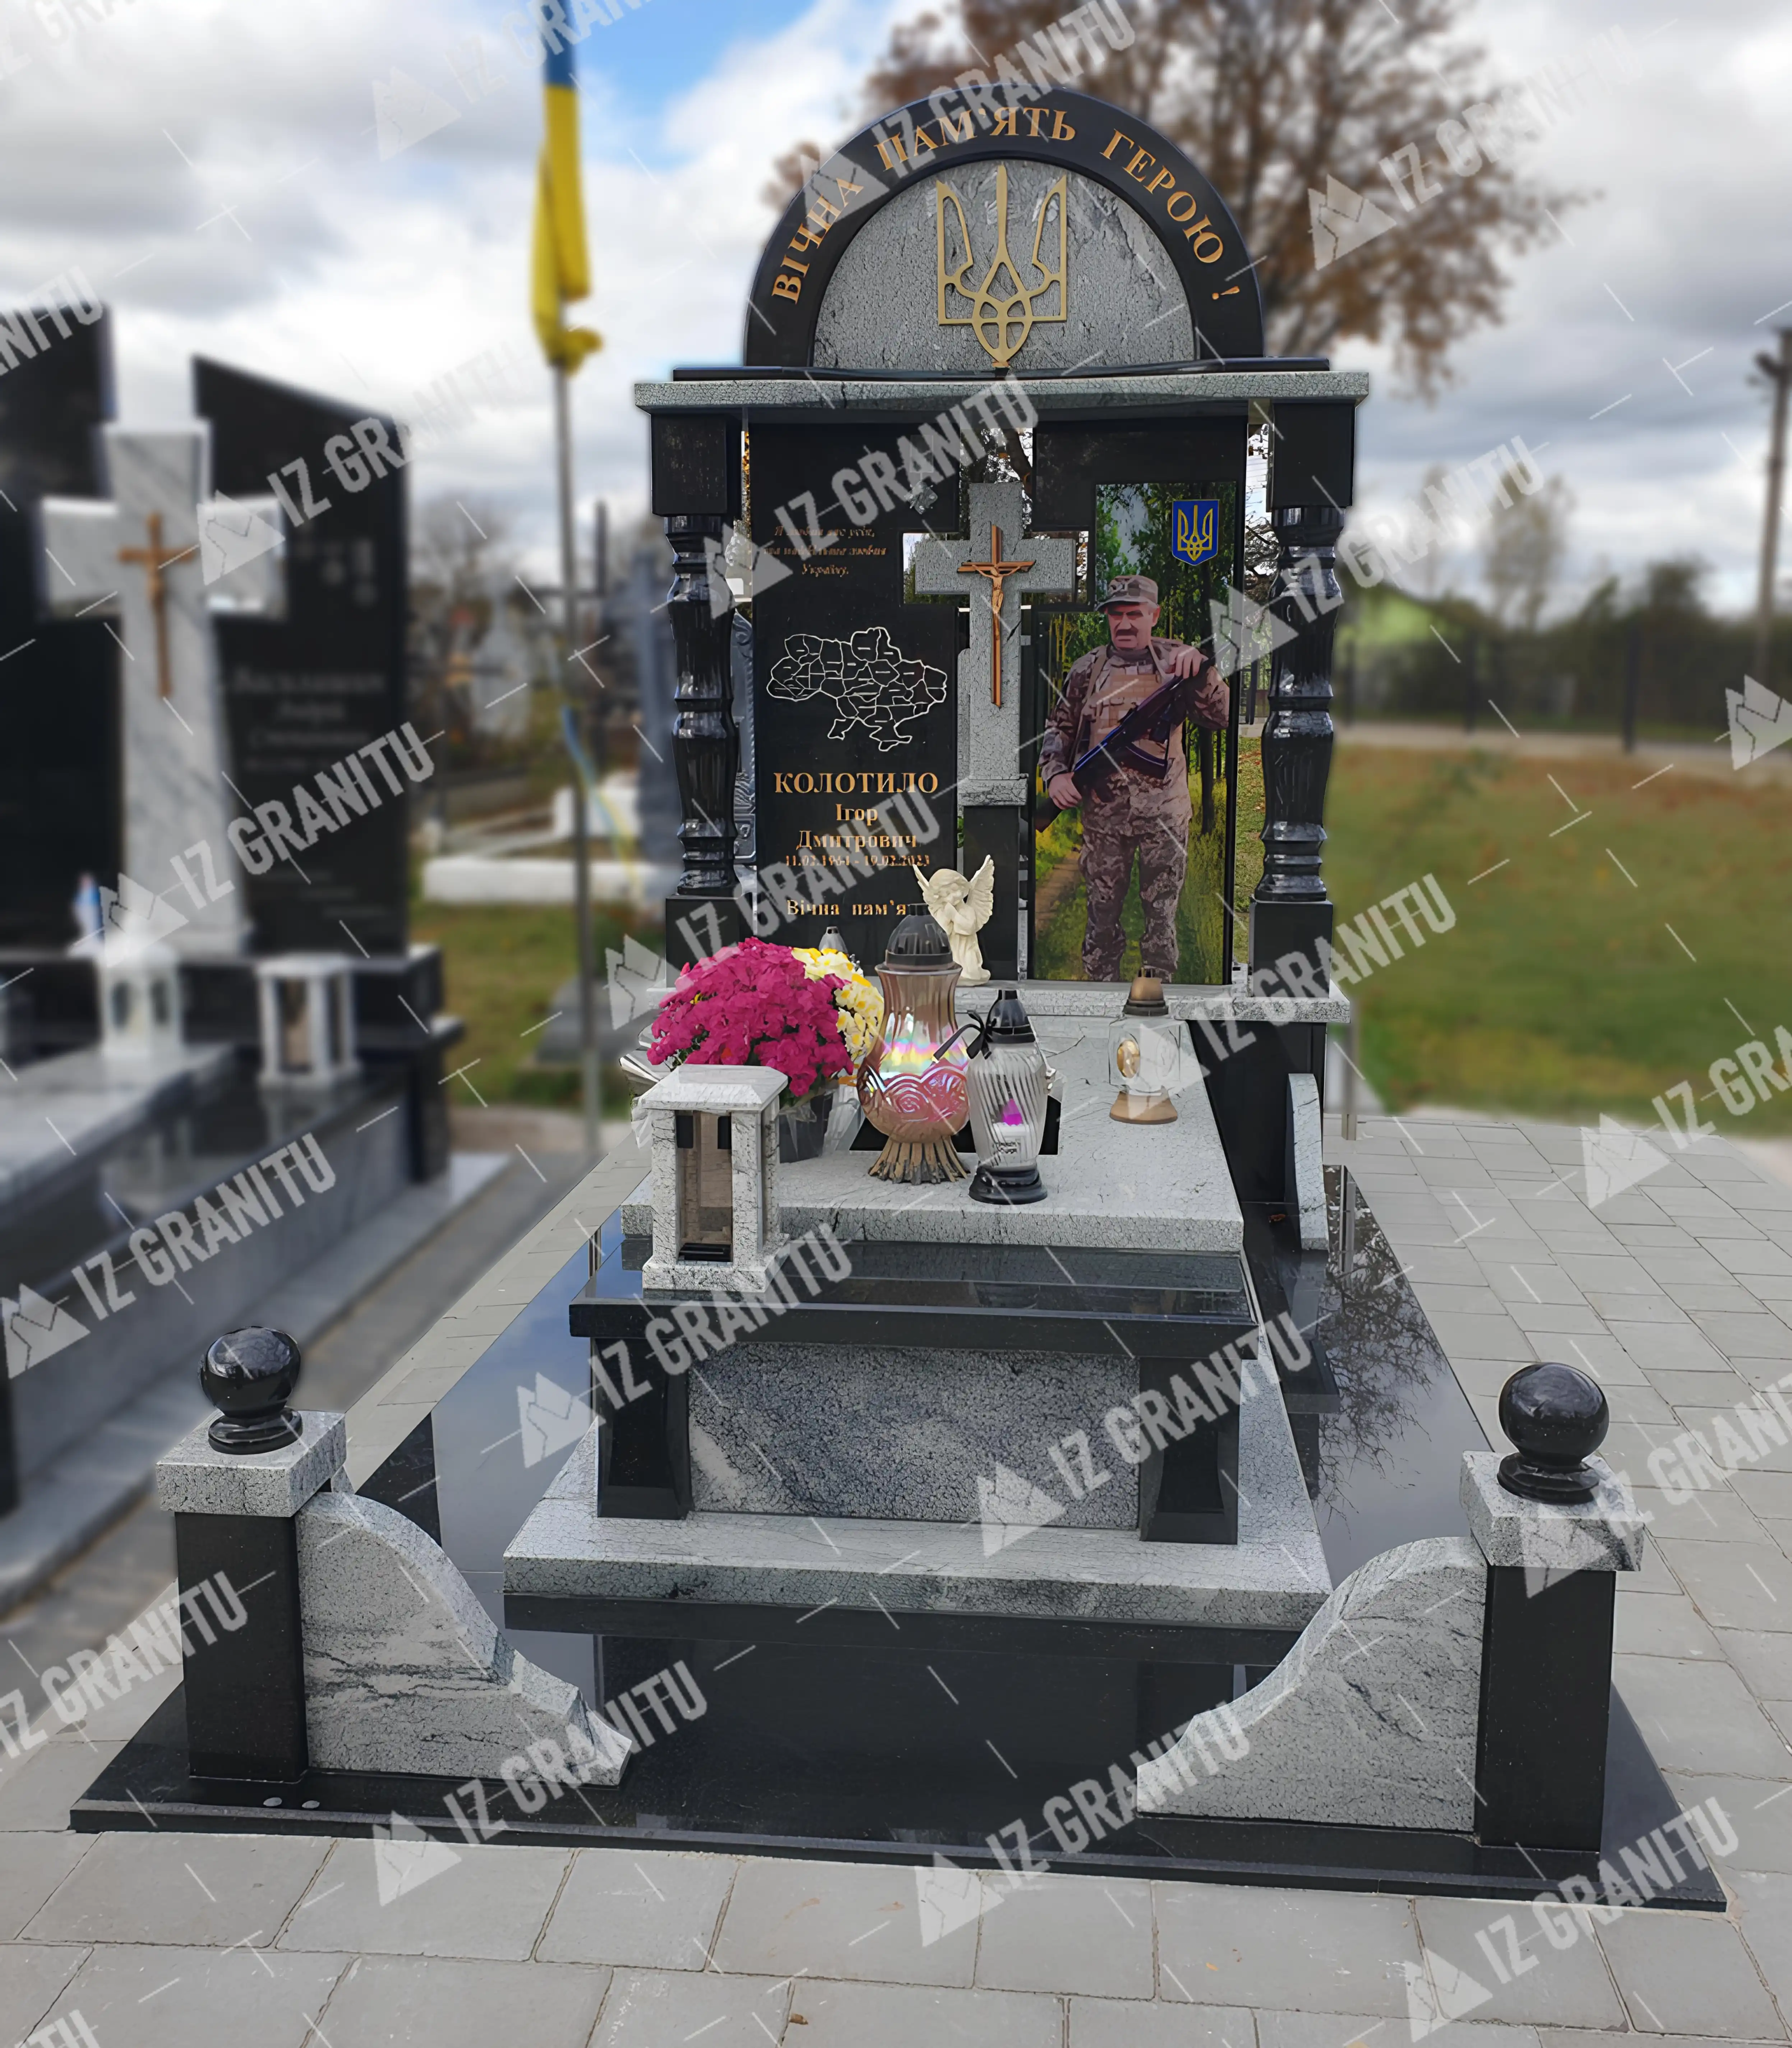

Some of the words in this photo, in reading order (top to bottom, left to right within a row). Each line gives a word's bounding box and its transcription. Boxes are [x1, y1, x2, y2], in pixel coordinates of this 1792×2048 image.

[772, 178, 864, 304] ВІЧНА
[873, 106, 1076, 172] ПАМ'ЯТЬ
[1099, 128, 1223, 263] ГЕРОЮ
[773, 772, 938, 794] КОЛОТИЛО
[836, 804, 878, 826] Ігор
[796, 830, 917, 852] Дмитрович
[787, 899, 840, 915] Вічна
[852, 900, 906, 915] пам'я
